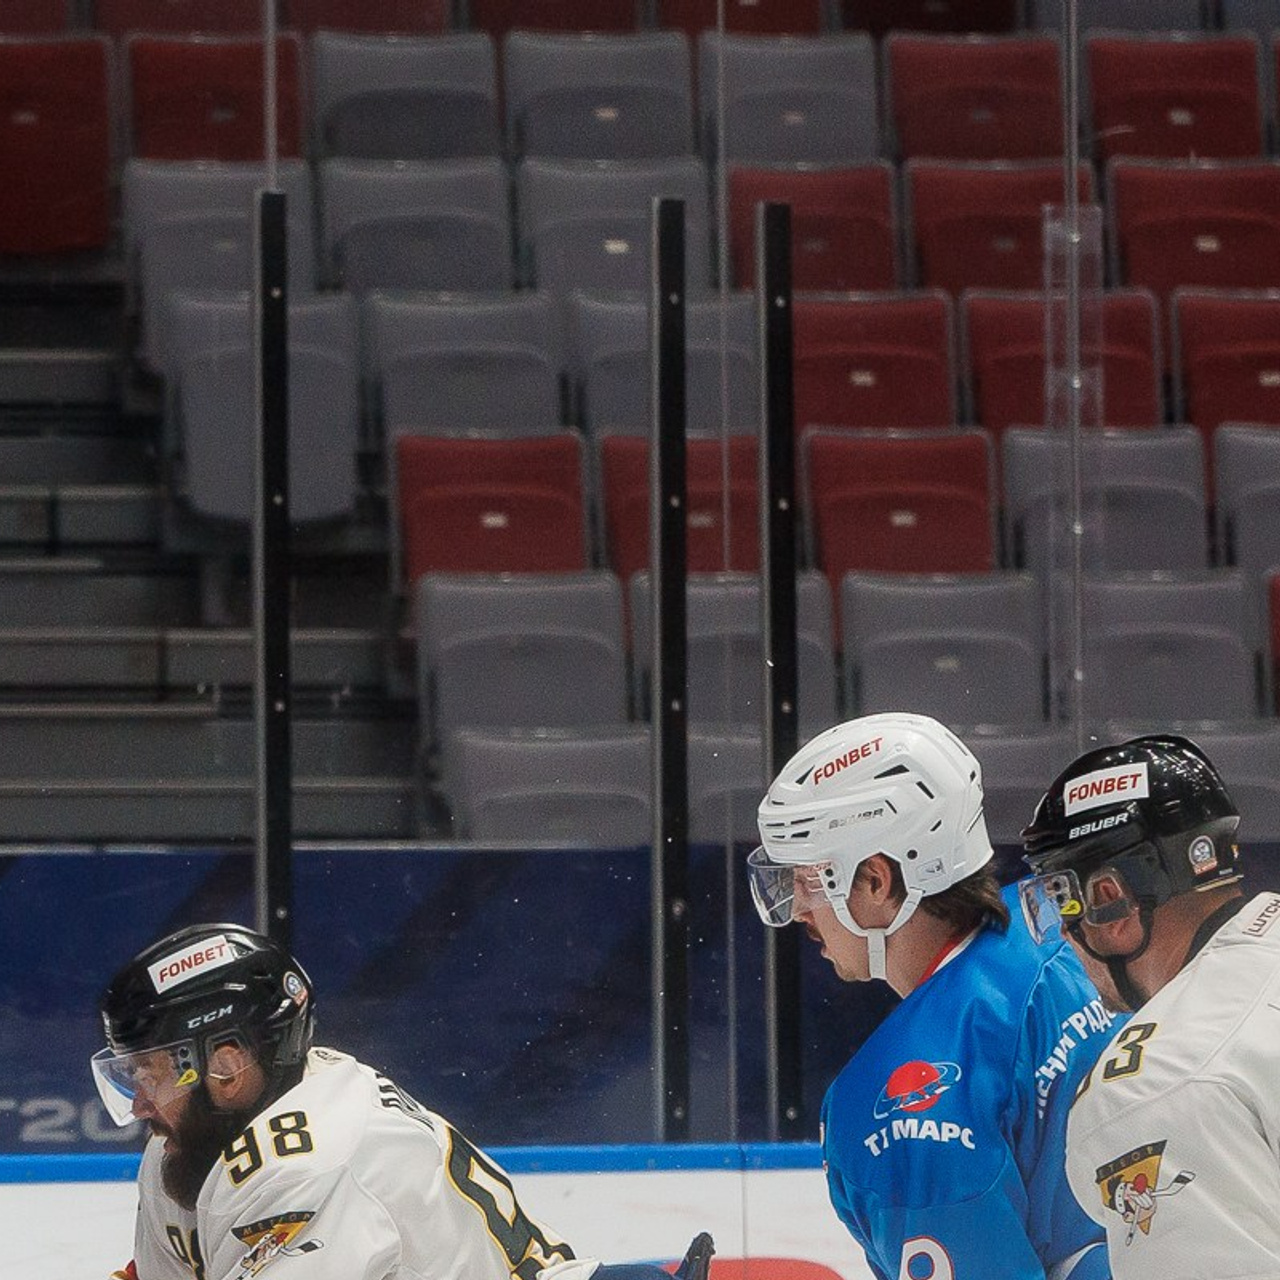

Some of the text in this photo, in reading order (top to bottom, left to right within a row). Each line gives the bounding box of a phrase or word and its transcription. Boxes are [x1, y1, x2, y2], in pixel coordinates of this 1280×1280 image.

[813, 737, 882, 785] FONBET
[1068, 773, 1142, 804] FONBET
[1069, 812, 1129, 840] BAUER
[159, 944, 225, 983] FONBET
[187, 1004, 233, 1029] CCM
[223, 1110, 315, 1187] 98
